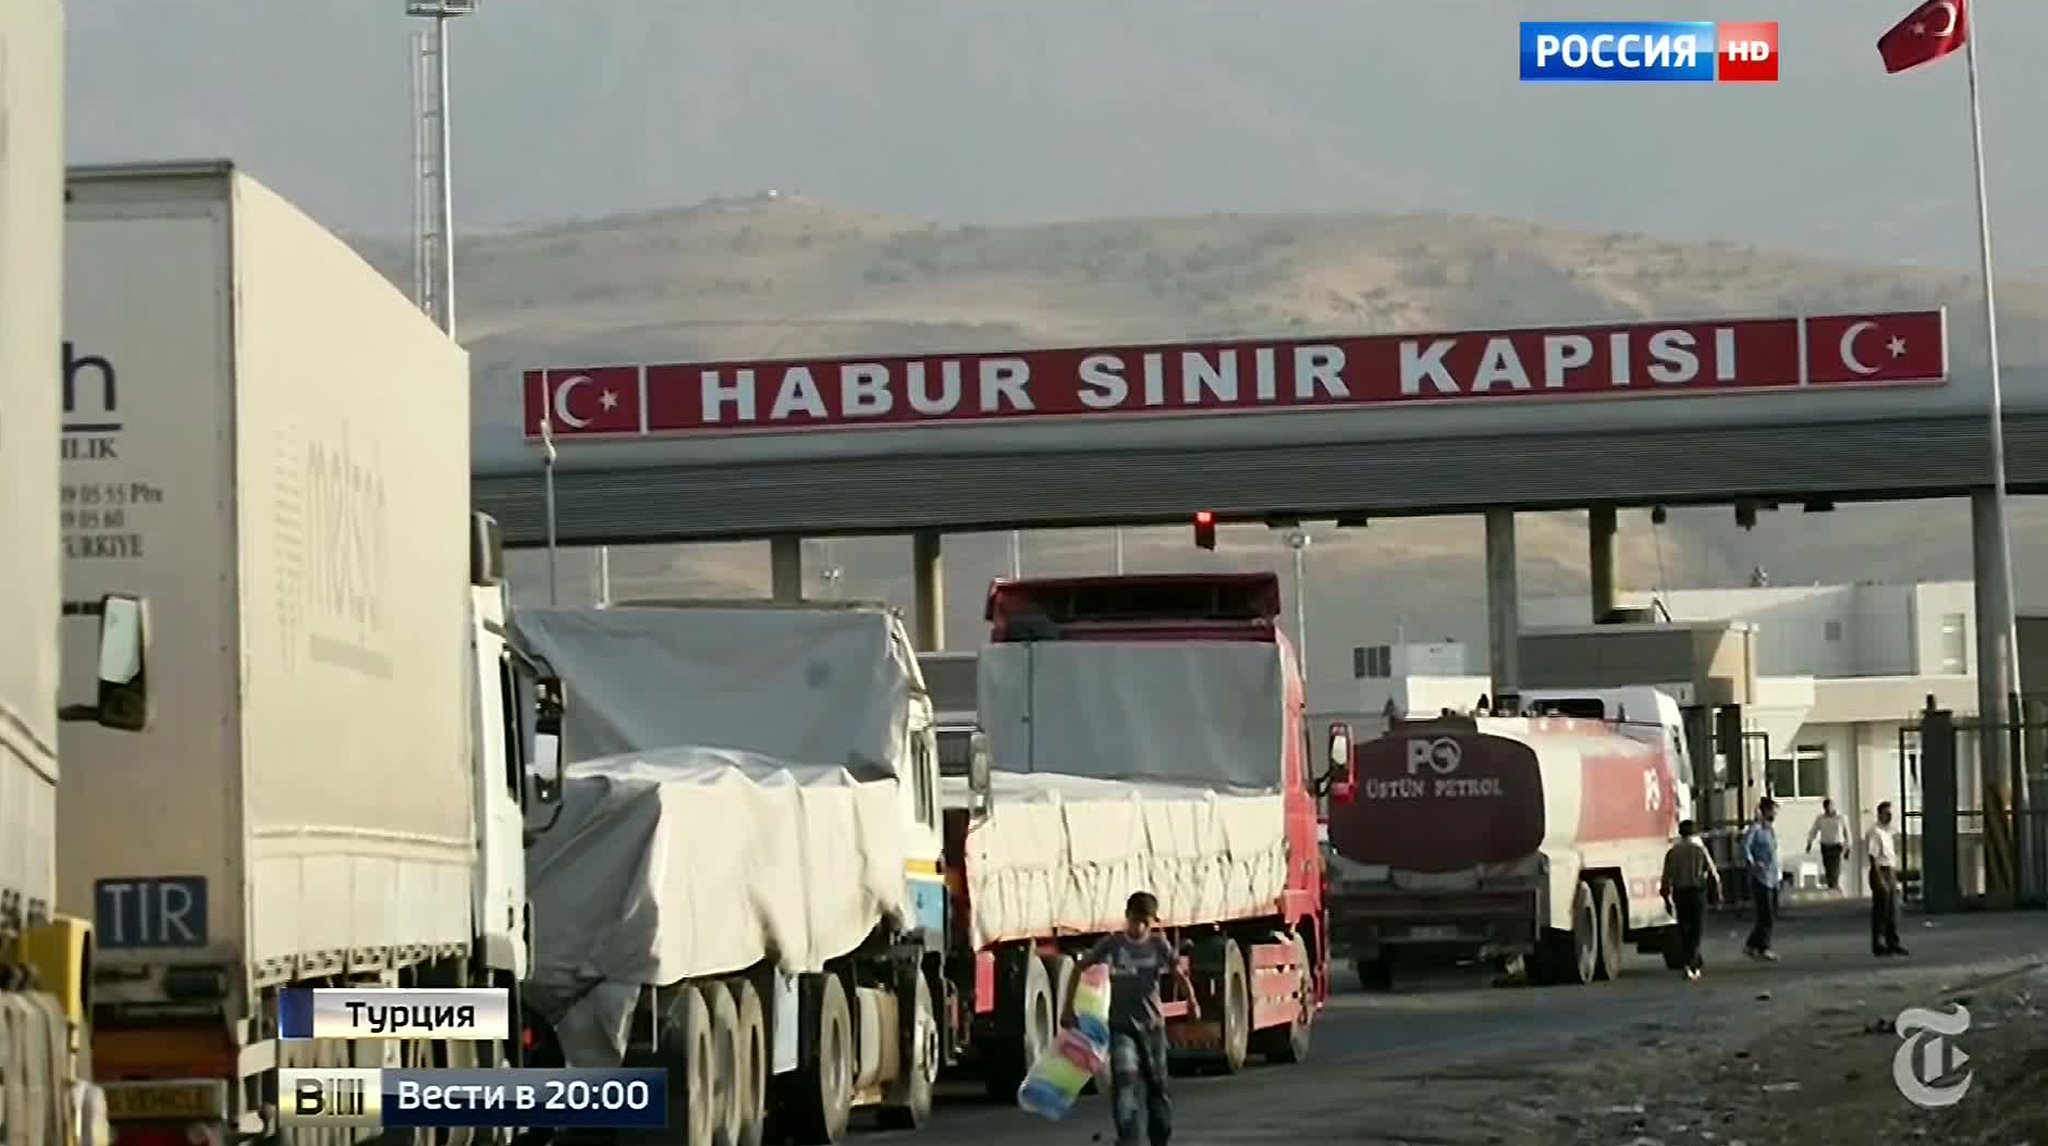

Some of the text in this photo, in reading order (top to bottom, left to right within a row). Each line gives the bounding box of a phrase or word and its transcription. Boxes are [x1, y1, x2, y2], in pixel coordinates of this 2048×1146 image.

[701, 327, 1736, 422] HABUR SINIR KAPISI
[103, 882, 196, 942] TIR
